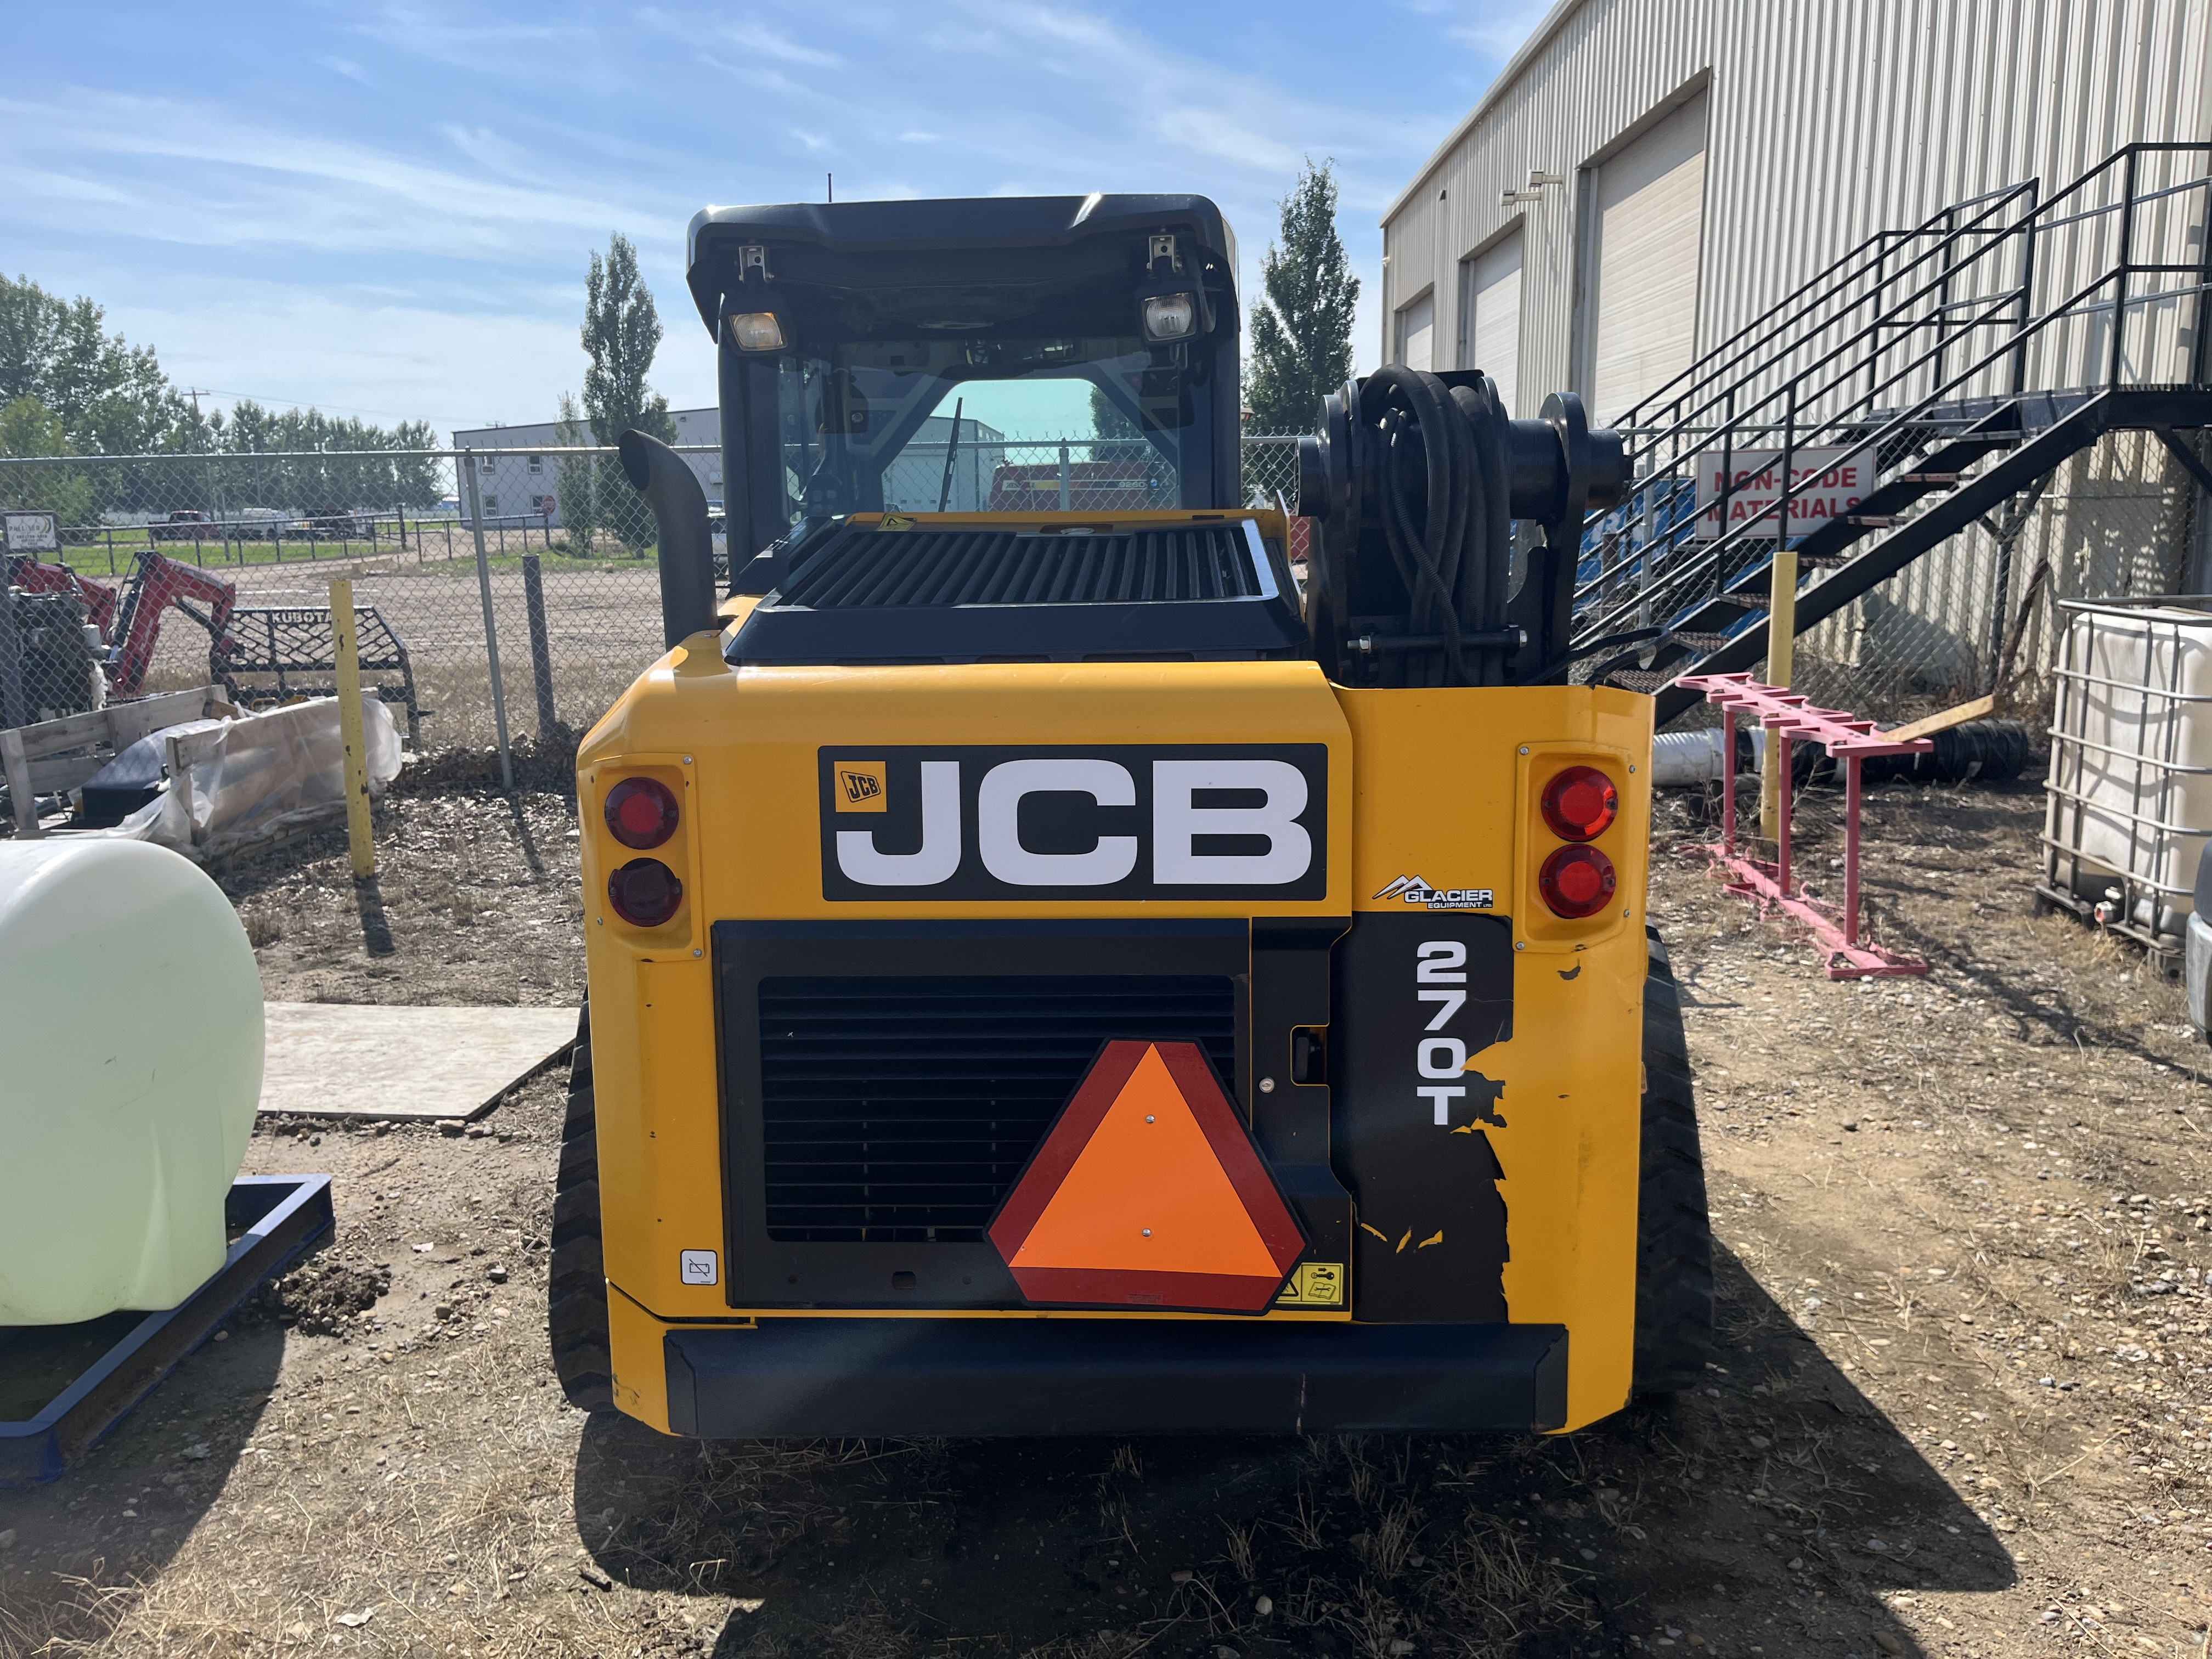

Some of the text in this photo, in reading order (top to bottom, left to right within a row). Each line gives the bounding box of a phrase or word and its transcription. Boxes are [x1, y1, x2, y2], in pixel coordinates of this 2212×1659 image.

[1714, 467, 1857, 492] NON-CODE
[848, 775, 878, 799] JCB
[836, 759, 1312, 886] JCB
[1404, 890, 1493, 902] GLACIER
[1417, 940, 1466, 1125] 270T
